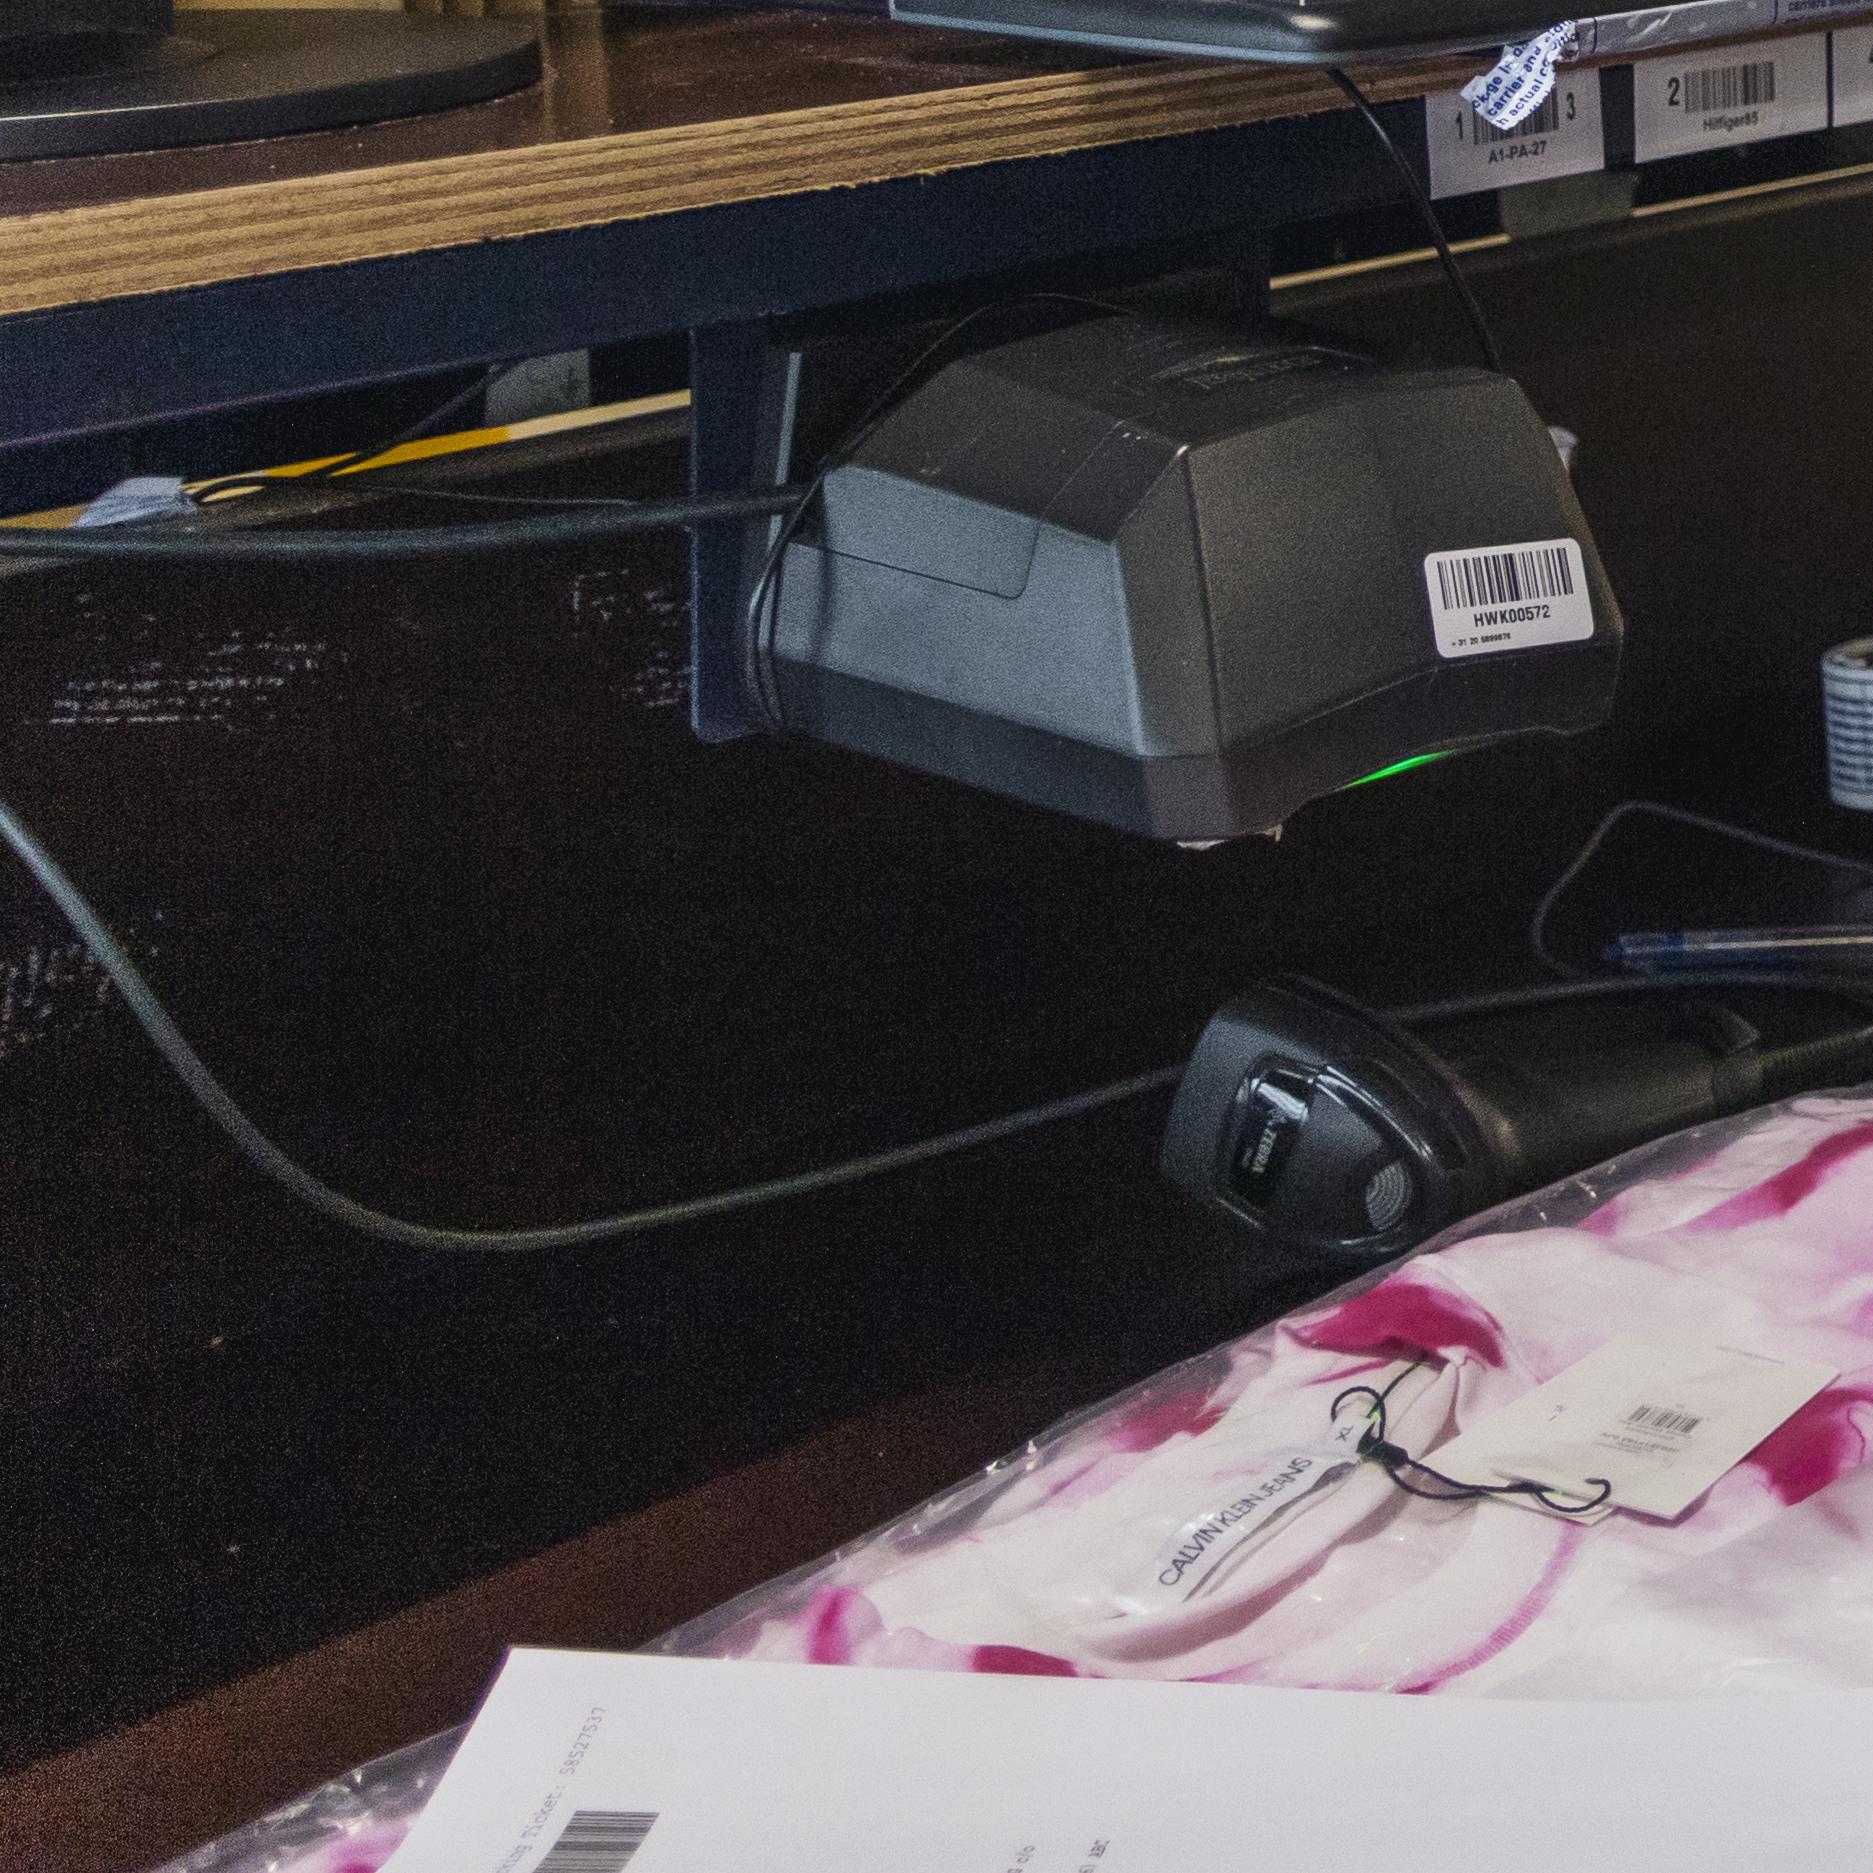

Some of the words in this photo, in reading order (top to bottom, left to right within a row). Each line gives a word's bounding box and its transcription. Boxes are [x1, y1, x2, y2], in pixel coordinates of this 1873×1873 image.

[1487, 76, 1525, 117] carrier
[1508, 78, 1544, 117] actual
[1667, 76, 1680, 107] 2
[1454, 111, 1465, 141] 1
[1565, 91, 1577, 121] 3
[1487, 139, 1548, 164] A1-PA-27
[1473, 604, 1551, 628] HWK00572
[1335, 1425, 1354, 1443] XL
[1158, 1522, 1223, 1586] CALVIN
[1219, 1492, 1265, 1528] KLEIN
[1259, 1456, 1313, 1497] JEANS
[520, 1784, 567, 1839] Ticket:
[559, 1706, 607, 1776] 58527537
